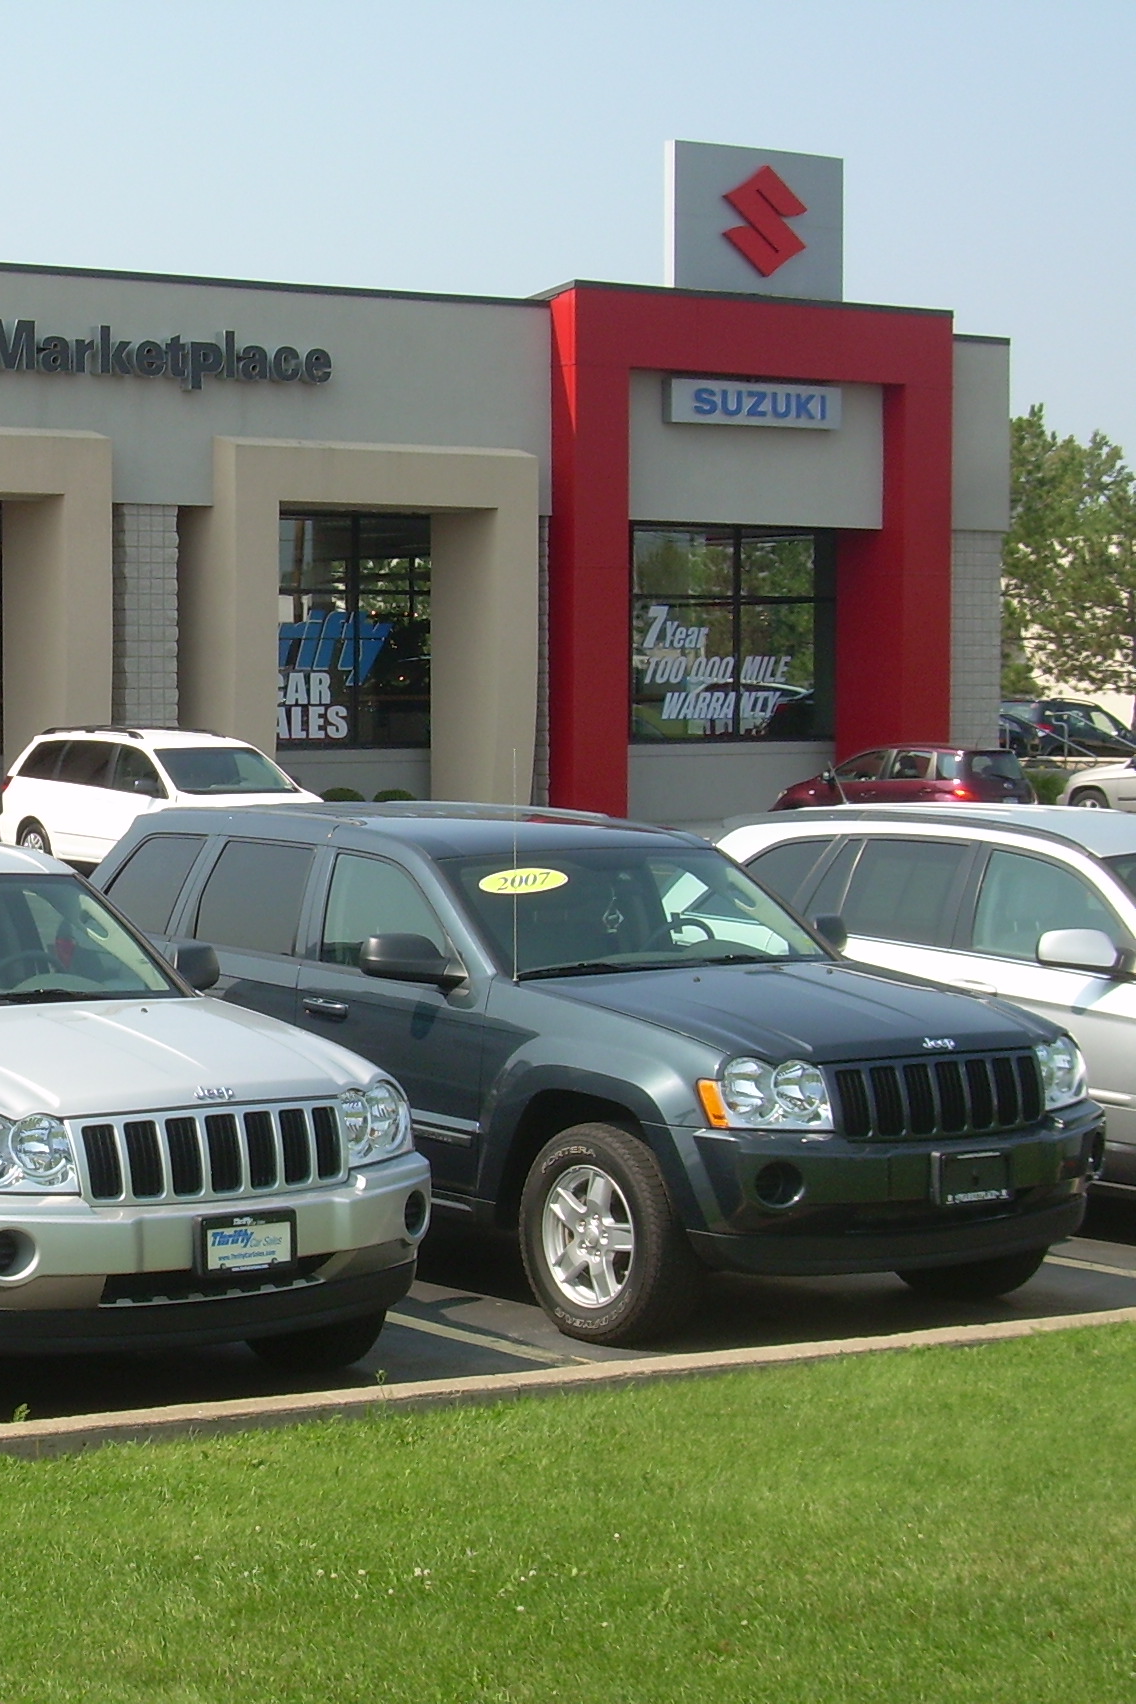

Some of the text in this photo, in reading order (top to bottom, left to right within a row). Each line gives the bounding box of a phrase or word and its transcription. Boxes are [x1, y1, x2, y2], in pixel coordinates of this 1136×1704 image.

[693, 387, 827, 420] SUZUKI
[643, 605, 709, 648] 7 Year
[740, 656, 792, 682] MILE
[661, 691, 781, 720] WARRANTY
[497, 871, 551, 892] 2007
[922, 1037, 956, 1050] Jeep
[193, 1085, 234, 1100] Jeep
[211, 1228, 255, 1249] Thrifty
